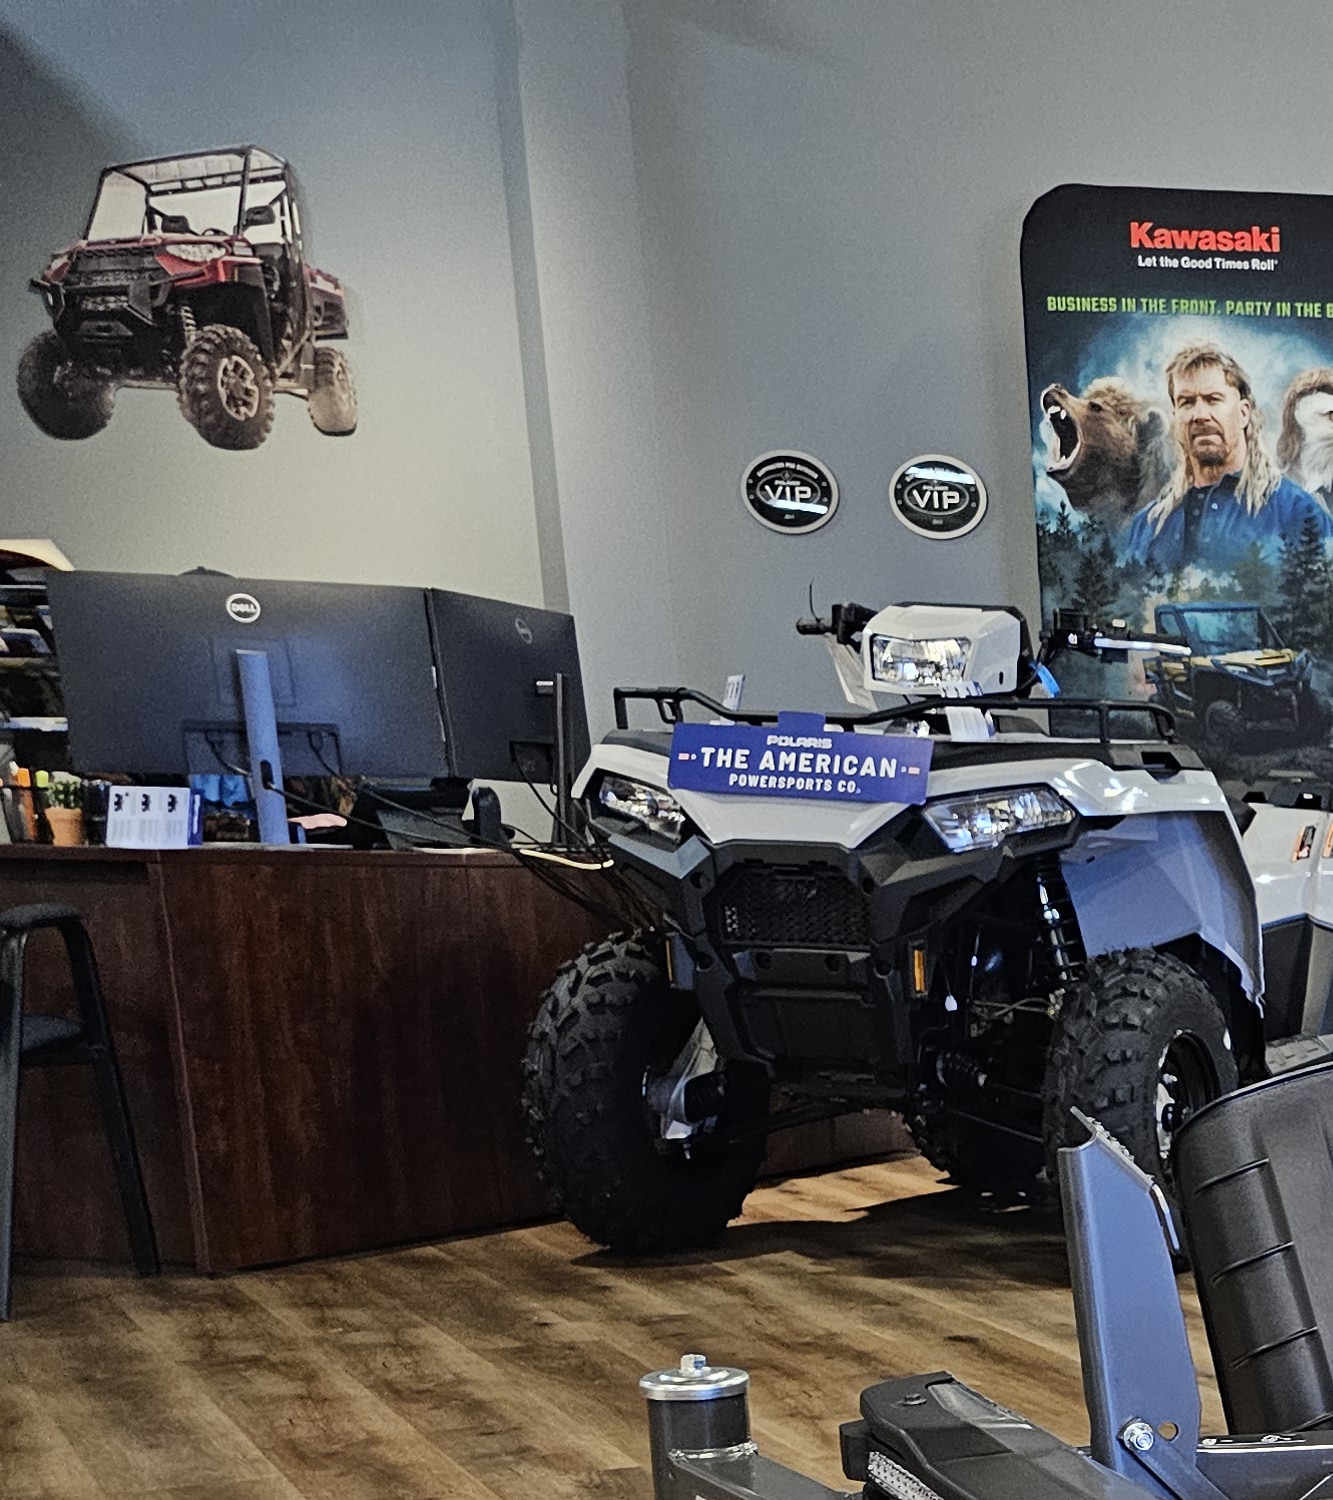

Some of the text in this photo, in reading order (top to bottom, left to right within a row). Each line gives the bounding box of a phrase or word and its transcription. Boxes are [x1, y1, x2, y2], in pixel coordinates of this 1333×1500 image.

[1130, 222, 1280, 252] Kawasaki
[1138, 255, 1157, 268] Let
[1160, 255, 1178, 268] the
[1181, 256, 1212, 269] Good
[1214, 257, 1249, 270] Times
[1047, 296, 1116, 312] BUSINESS
[1122, 298, 1136, 312] IN
[1140, 298, 1167, 314] THE
[1171, 299, 1221, 315] FRONT.
[1226, 301, 1271, 317] PARTY
[1276, 302, 1291, 317] IN
[1295, 302, 1321, 318] THE
[764, 485, 811, 504] VIP
[913, 489, 959, 509] VIP
[767, 735, 832, 749] POLARIS
[701, 747, 897, 778] THE AMERICAN
[729, 773, 832, 792] POWERSPORTS
